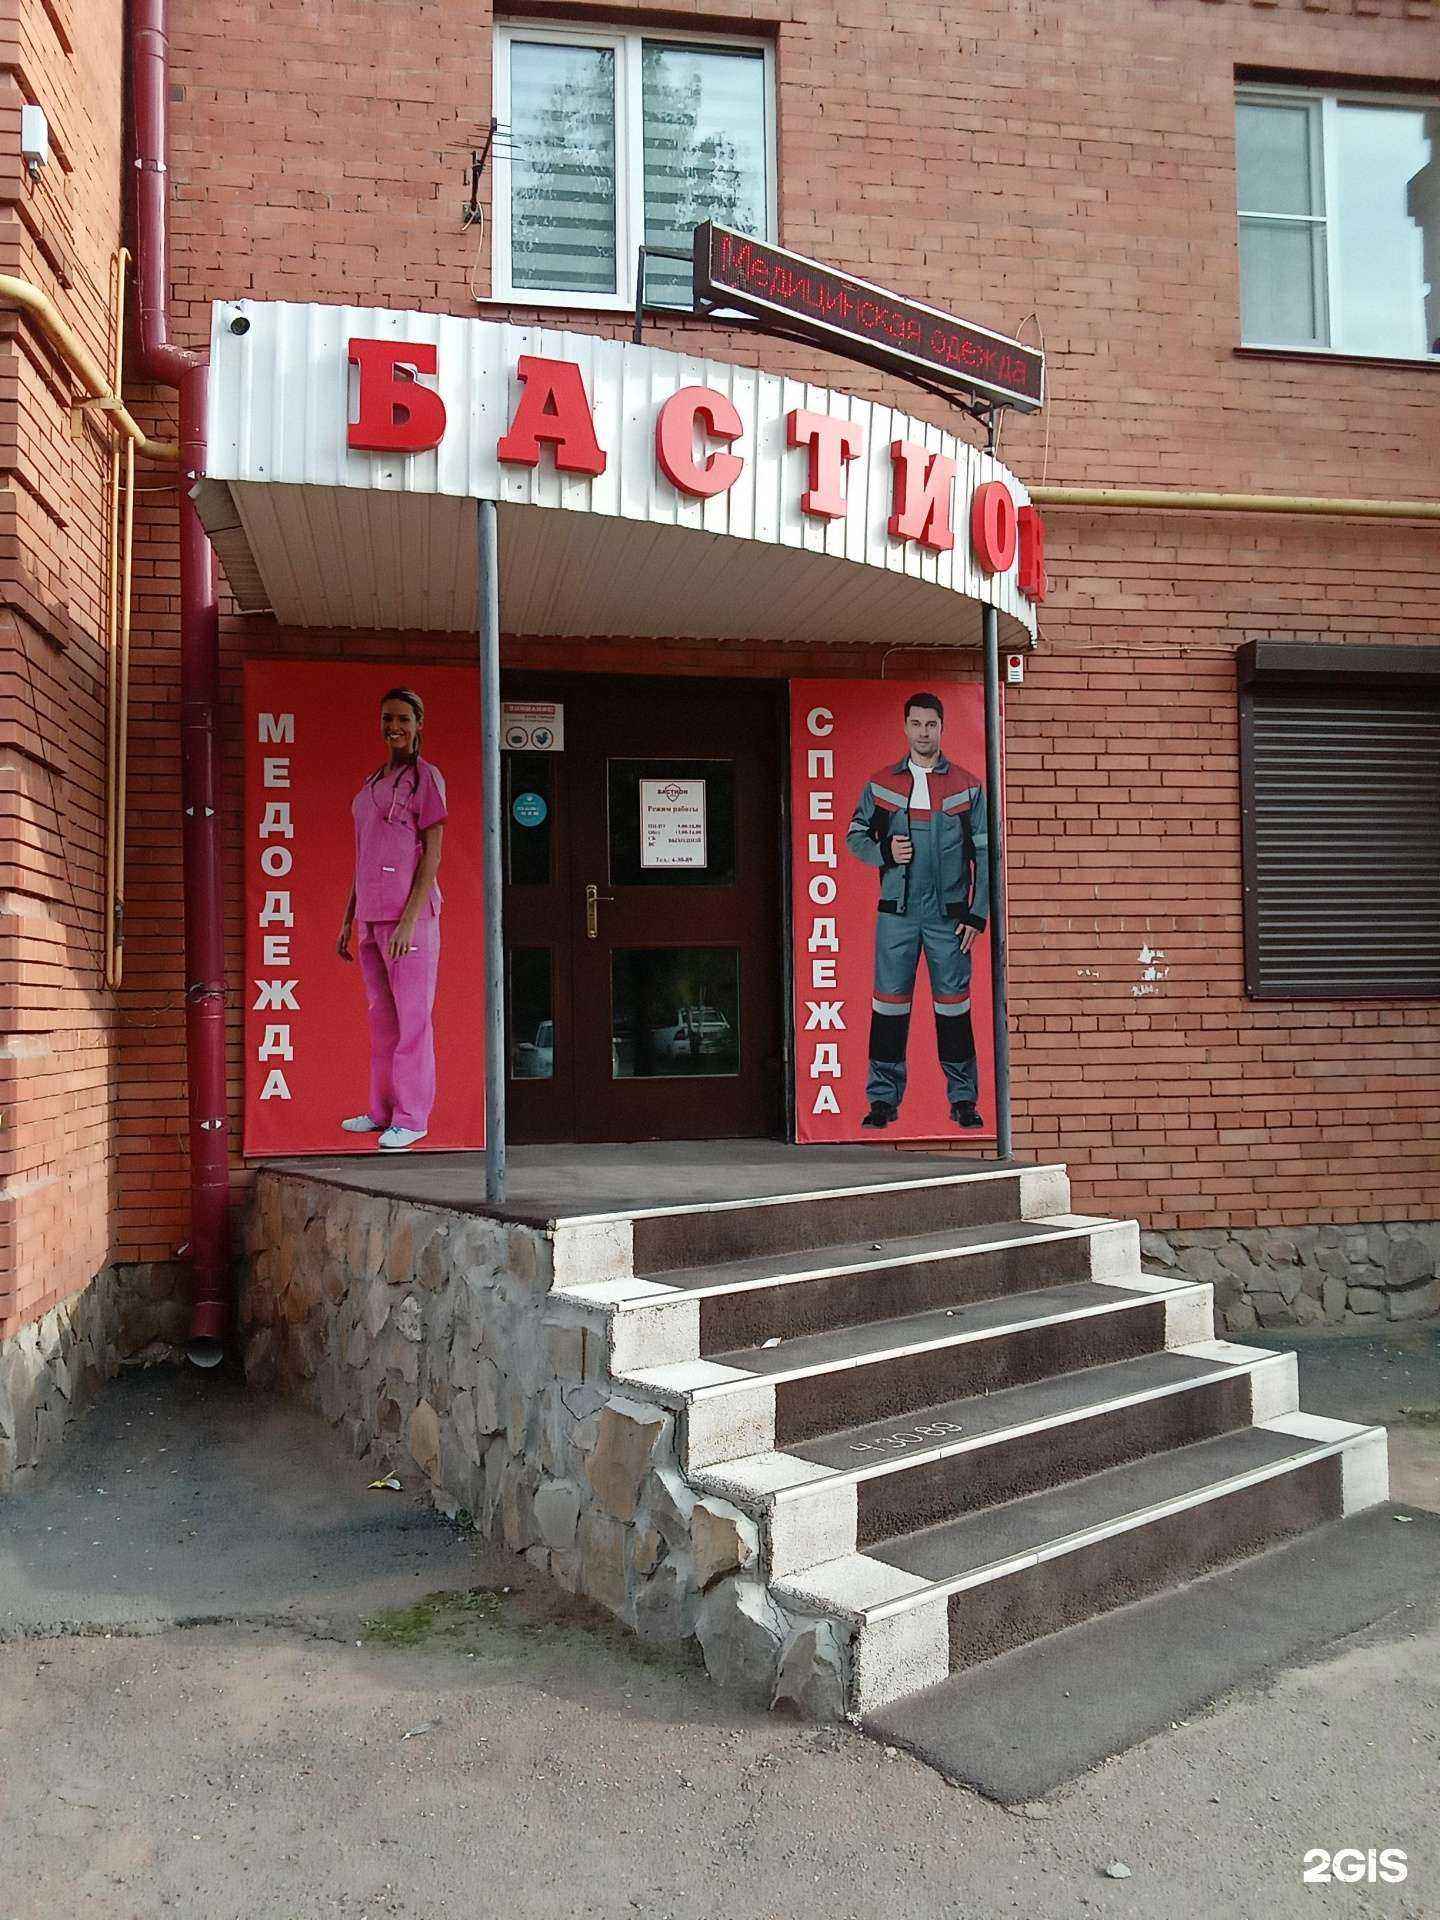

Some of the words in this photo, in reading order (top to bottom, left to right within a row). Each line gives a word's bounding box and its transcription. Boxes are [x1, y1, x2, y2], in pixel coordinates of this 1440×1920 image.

[346, 338, 1046, 604] БАСТИОН
[720, 234, 922, 343] Медицинская
[930, 329, 1028, 388] одежда
[252, 712, 301, 1101] МЕДОДЕЖДА
[804, 706, 847, 1114] СПЕЦОДЕЖДА
